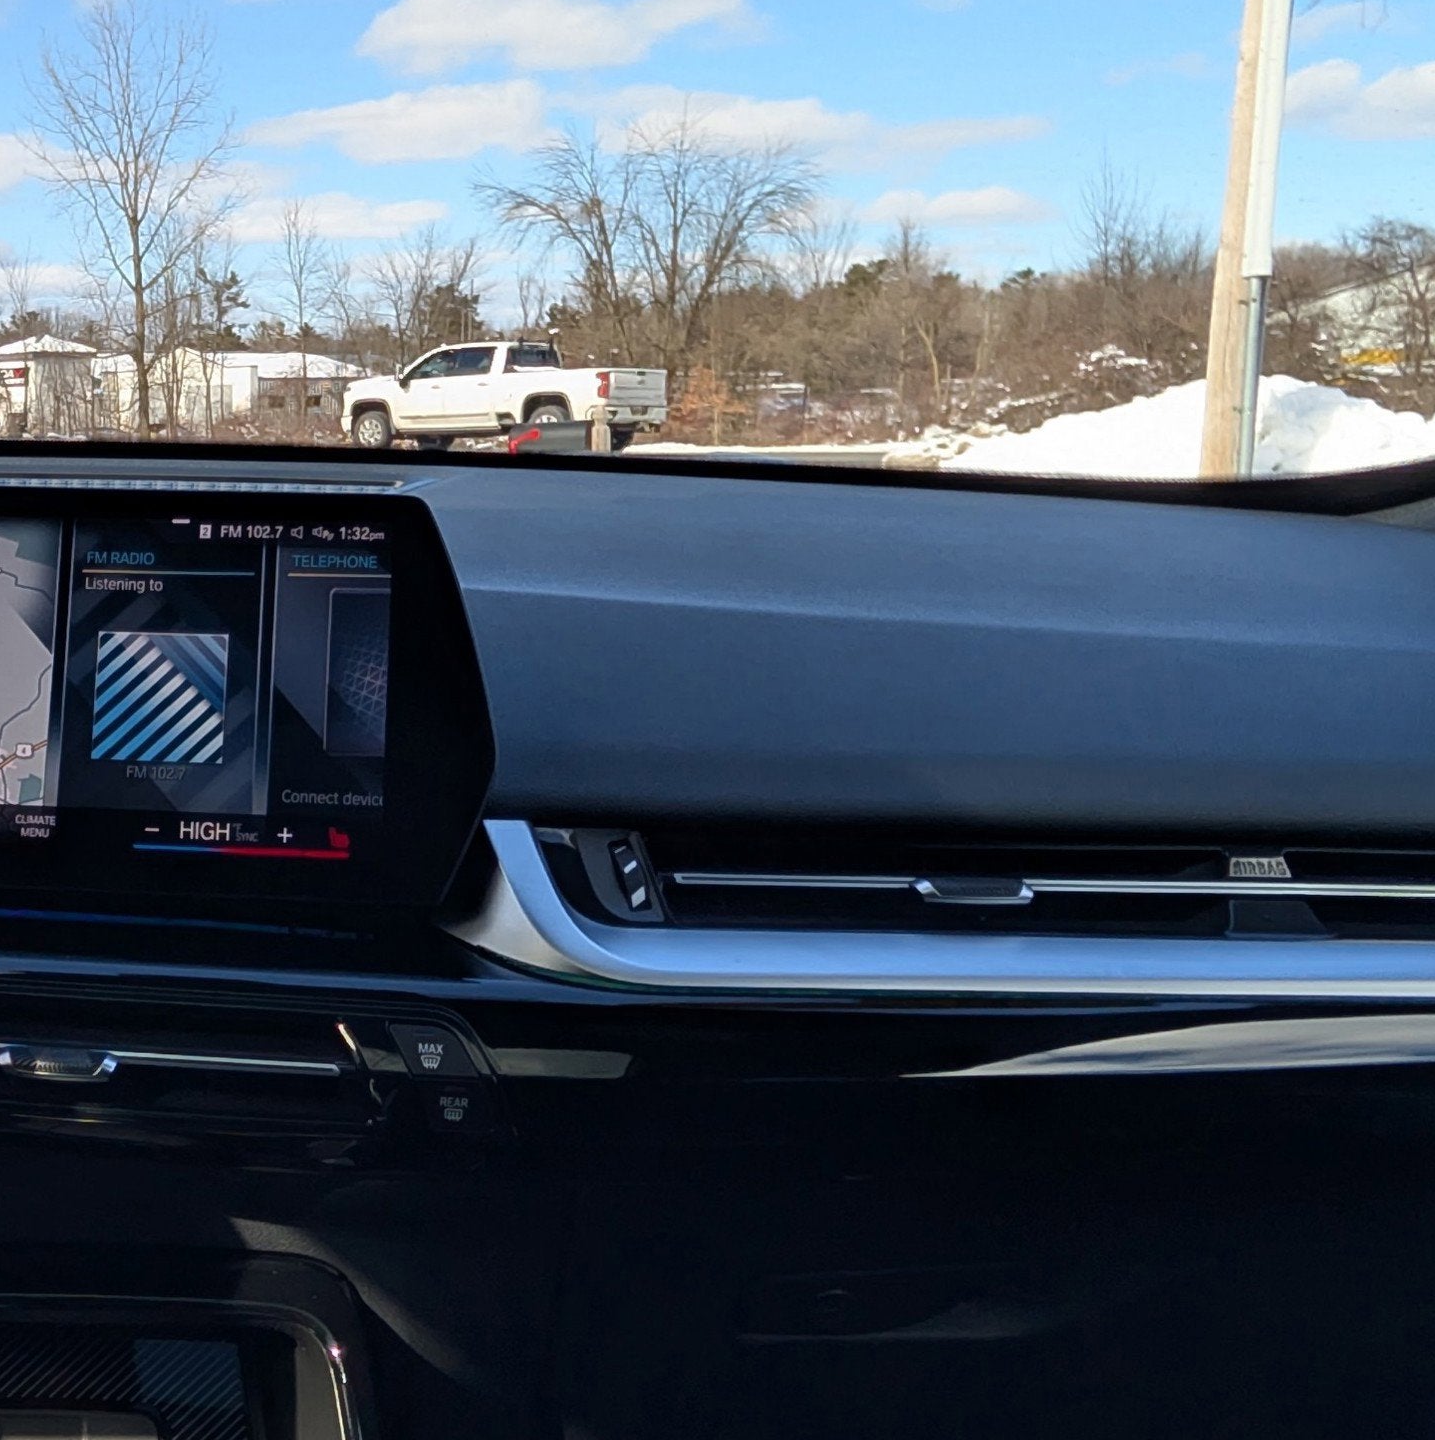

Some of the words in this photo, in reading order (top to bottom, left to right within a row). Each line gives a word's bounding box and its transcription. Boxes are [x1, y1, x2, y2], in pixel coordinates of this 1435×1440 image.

[220, 525, 242, 539] FM
[246, 525, 283, 540] 102.7
[339, 526, 385, 541] 1:32pm
[86, 551, 107, 564] FM
[110, 551, 155, 565] RADIO
[292, 554, 379, 569] TELEPHONE
[85, 576, 146, 594] Listening
[149, 578, 164, 592] to
[126, 765, 147, 779] FM
[151, 766, 185, 781] 102.7
[281, 789, 339, 806] Connect
[15, 814, 57, 826] CLIMATE
[20, 827, 51, 839] MENU
[180, 821, 231, 842] HIGH
[235, 831, 260, 843] SYNC
[1232, 859, 1287, 876] AIRBAG
[418, 1042, 444, 1055] MAX
[439, 1096, 469, 1108] REAR
